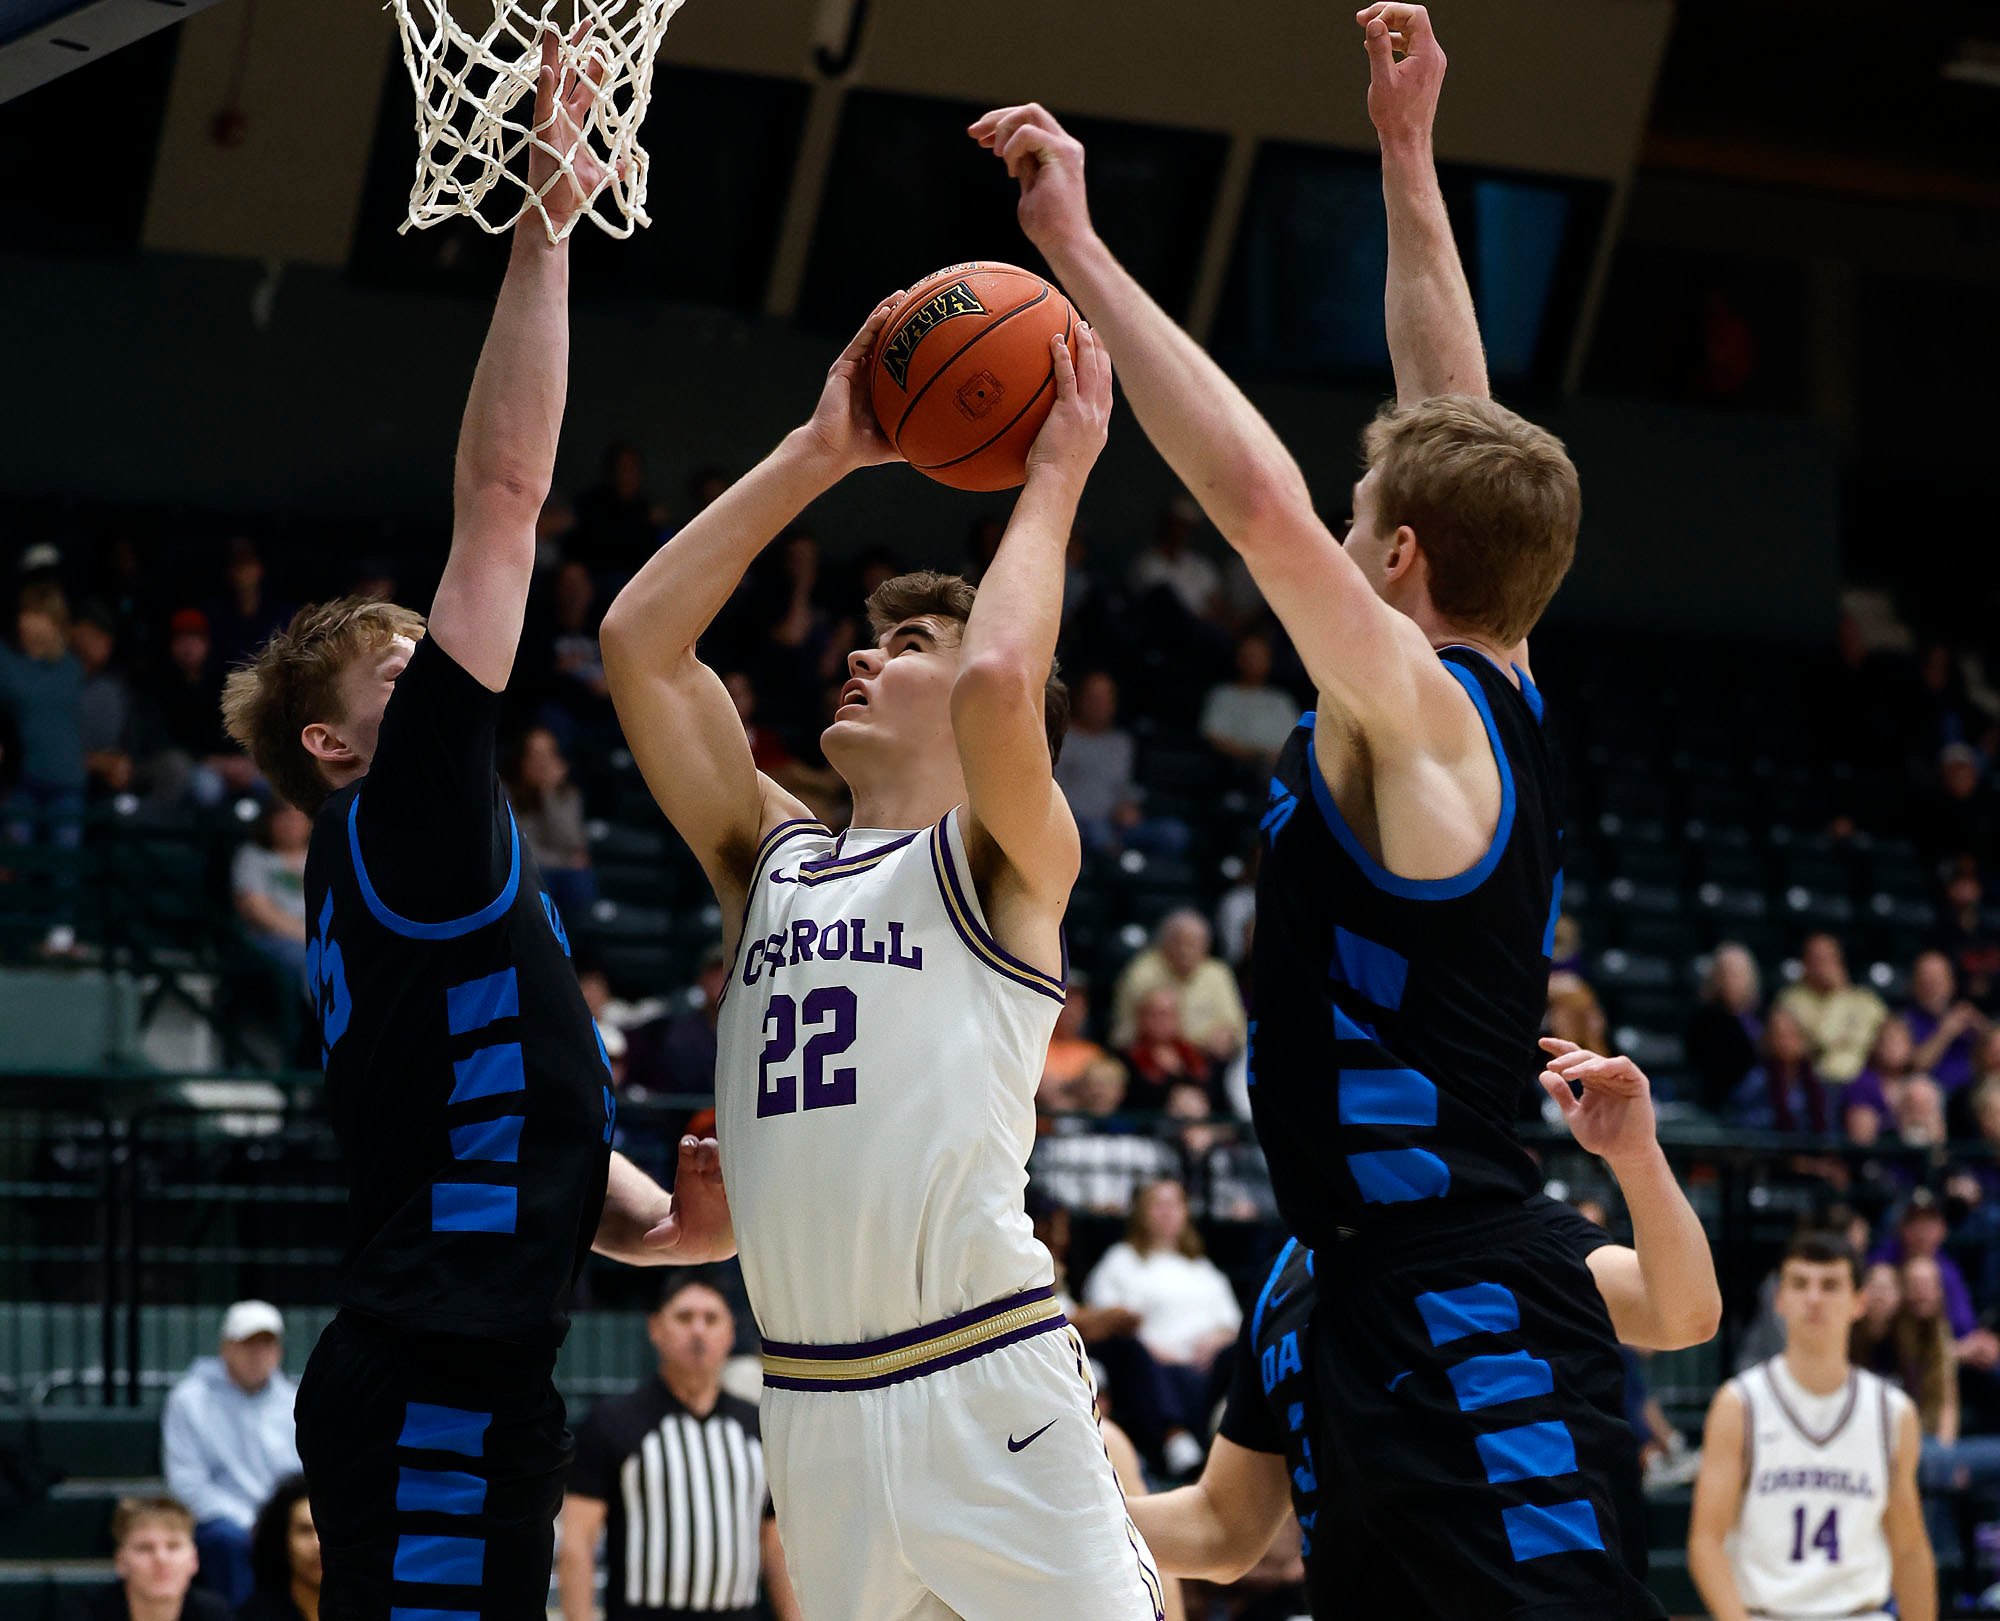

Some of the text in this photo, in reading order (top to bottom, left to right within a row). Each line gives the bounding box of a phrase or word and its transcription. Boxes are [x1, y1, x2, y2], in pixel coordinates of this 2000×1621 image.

[882, 281, 989, 392] NAIA
[757, 985, 858, 1119] 22
[1790, 1504, 1841, 1563] 14
